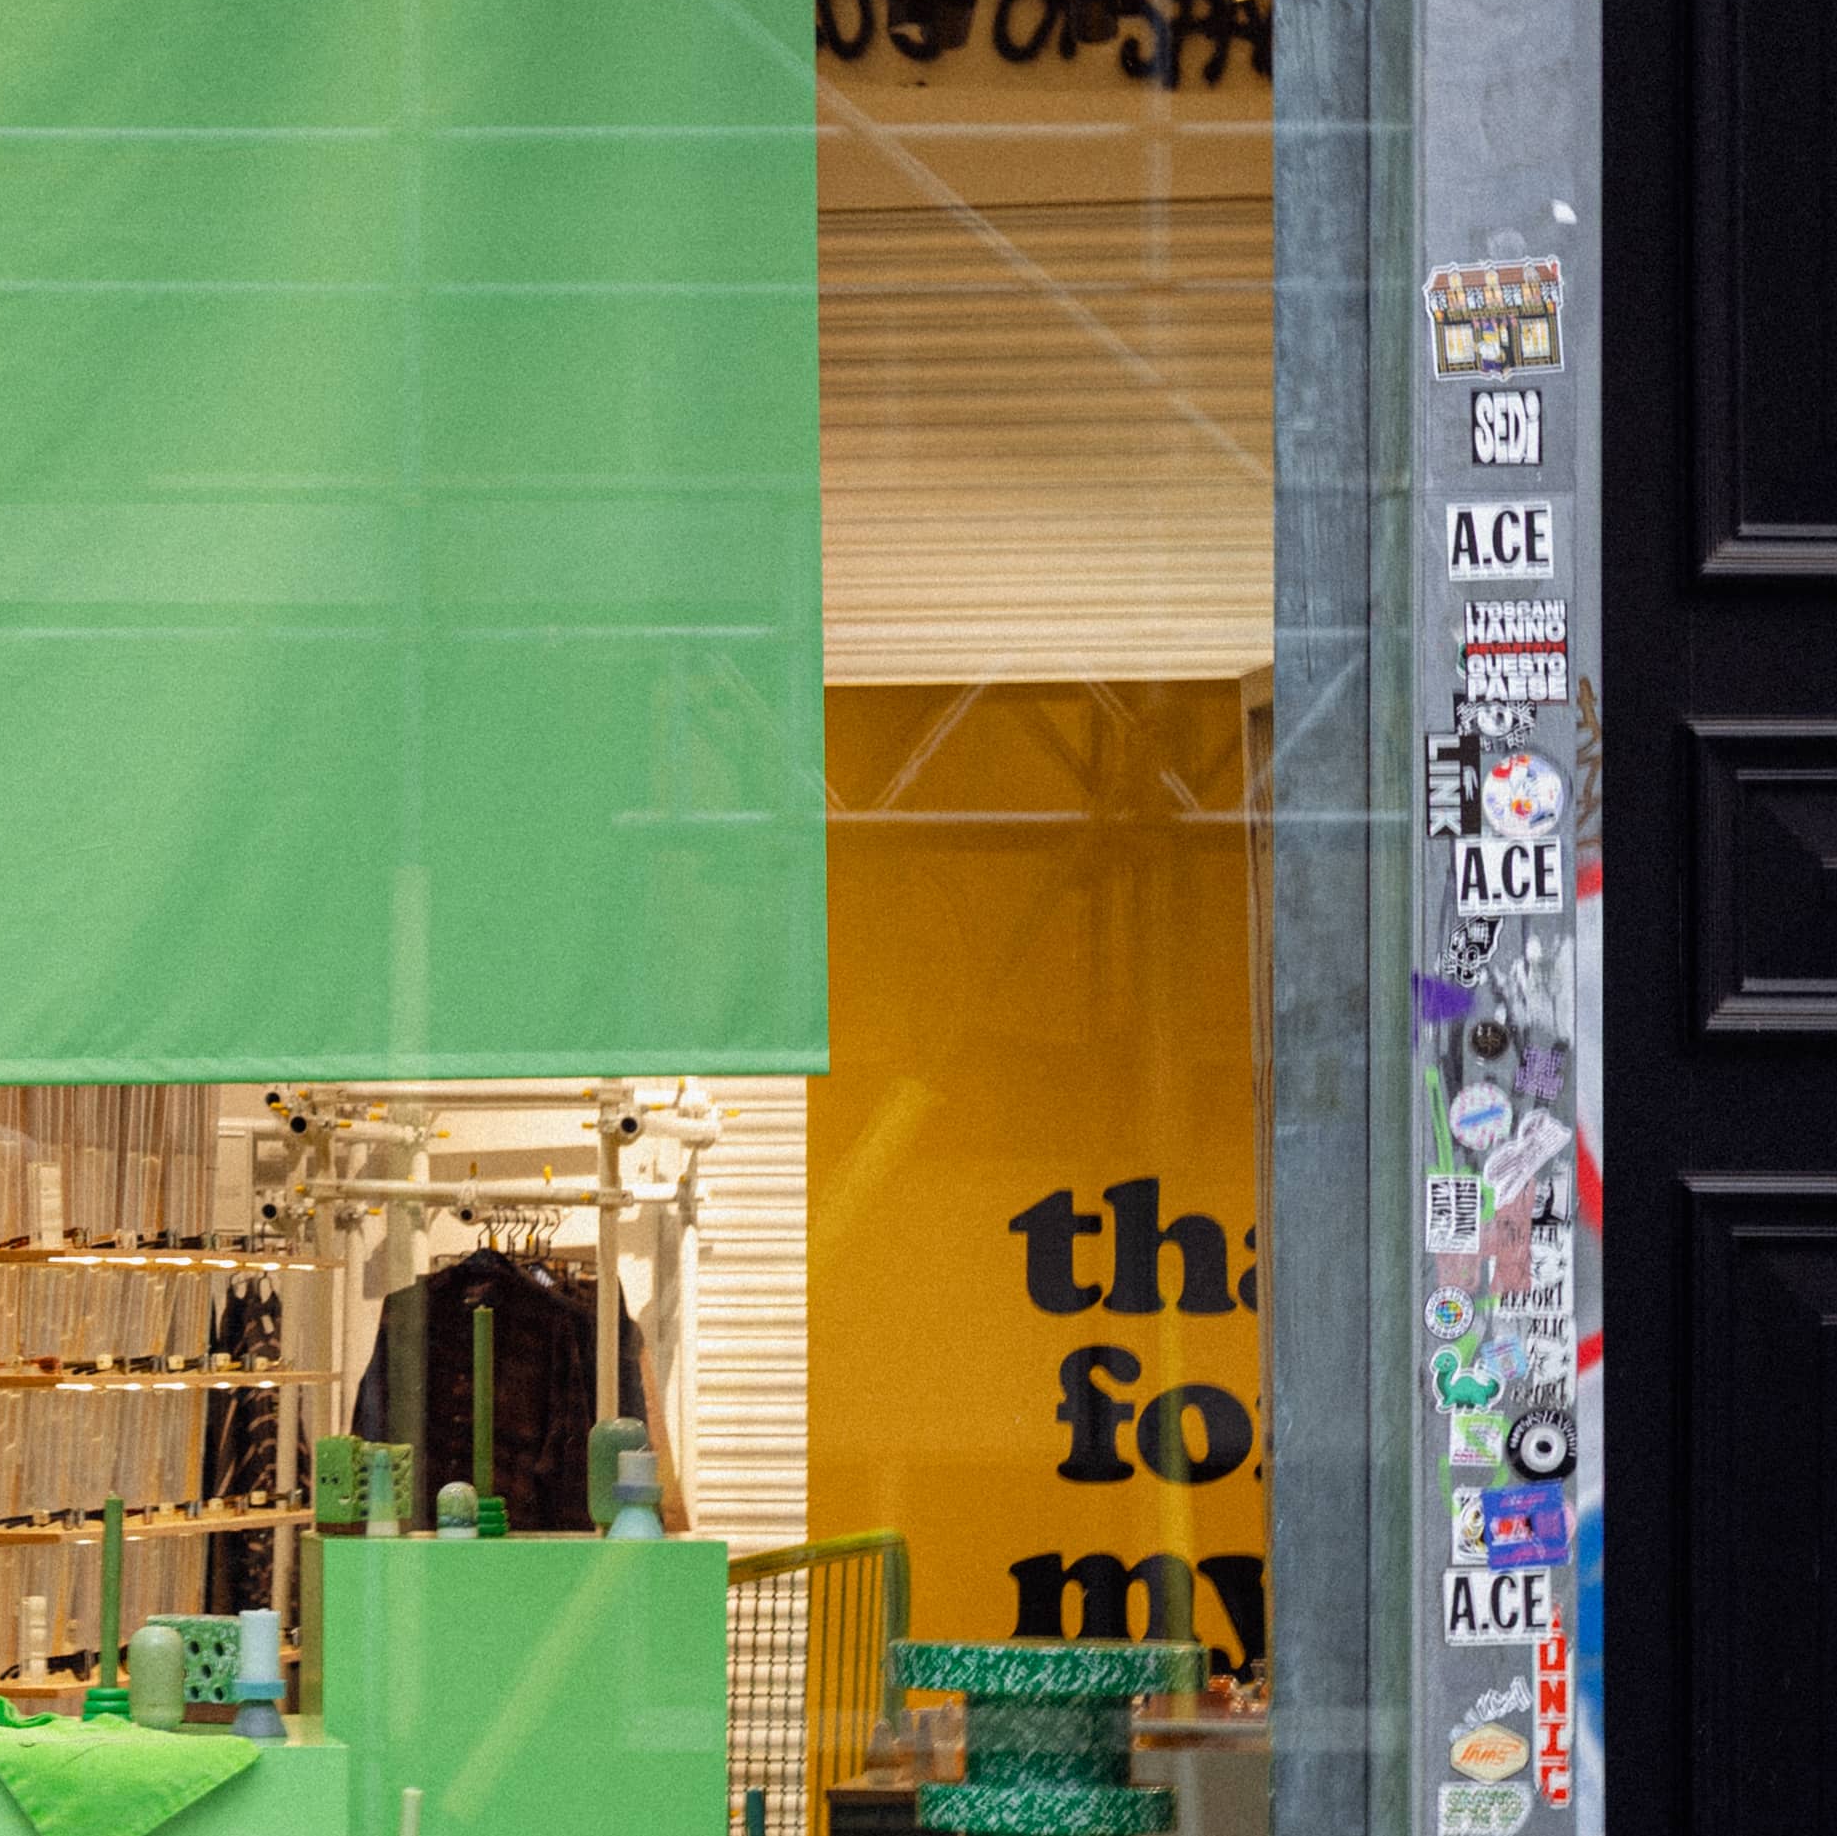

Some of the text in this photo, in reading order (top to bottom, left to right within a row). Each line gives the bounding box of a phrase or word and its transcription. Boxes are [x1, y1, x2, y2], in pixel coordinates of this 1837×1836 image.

[1452, 509, 1550, 565] A.CE
[1466, 619, 1567, 643] HANNO
[1474, 600, 1566, 621] TOSCANI
[1467, 652, 1567, 677] QUESTO
[1468, 675, 1568, 701] PAESE
[1427, 733, 1462, 837] LINK
[1461, 844, 1559, 901] A.CE
[1056, 1346, 1262, 1485] fo
[1449, 1575, 1547, 1631] A.CE
